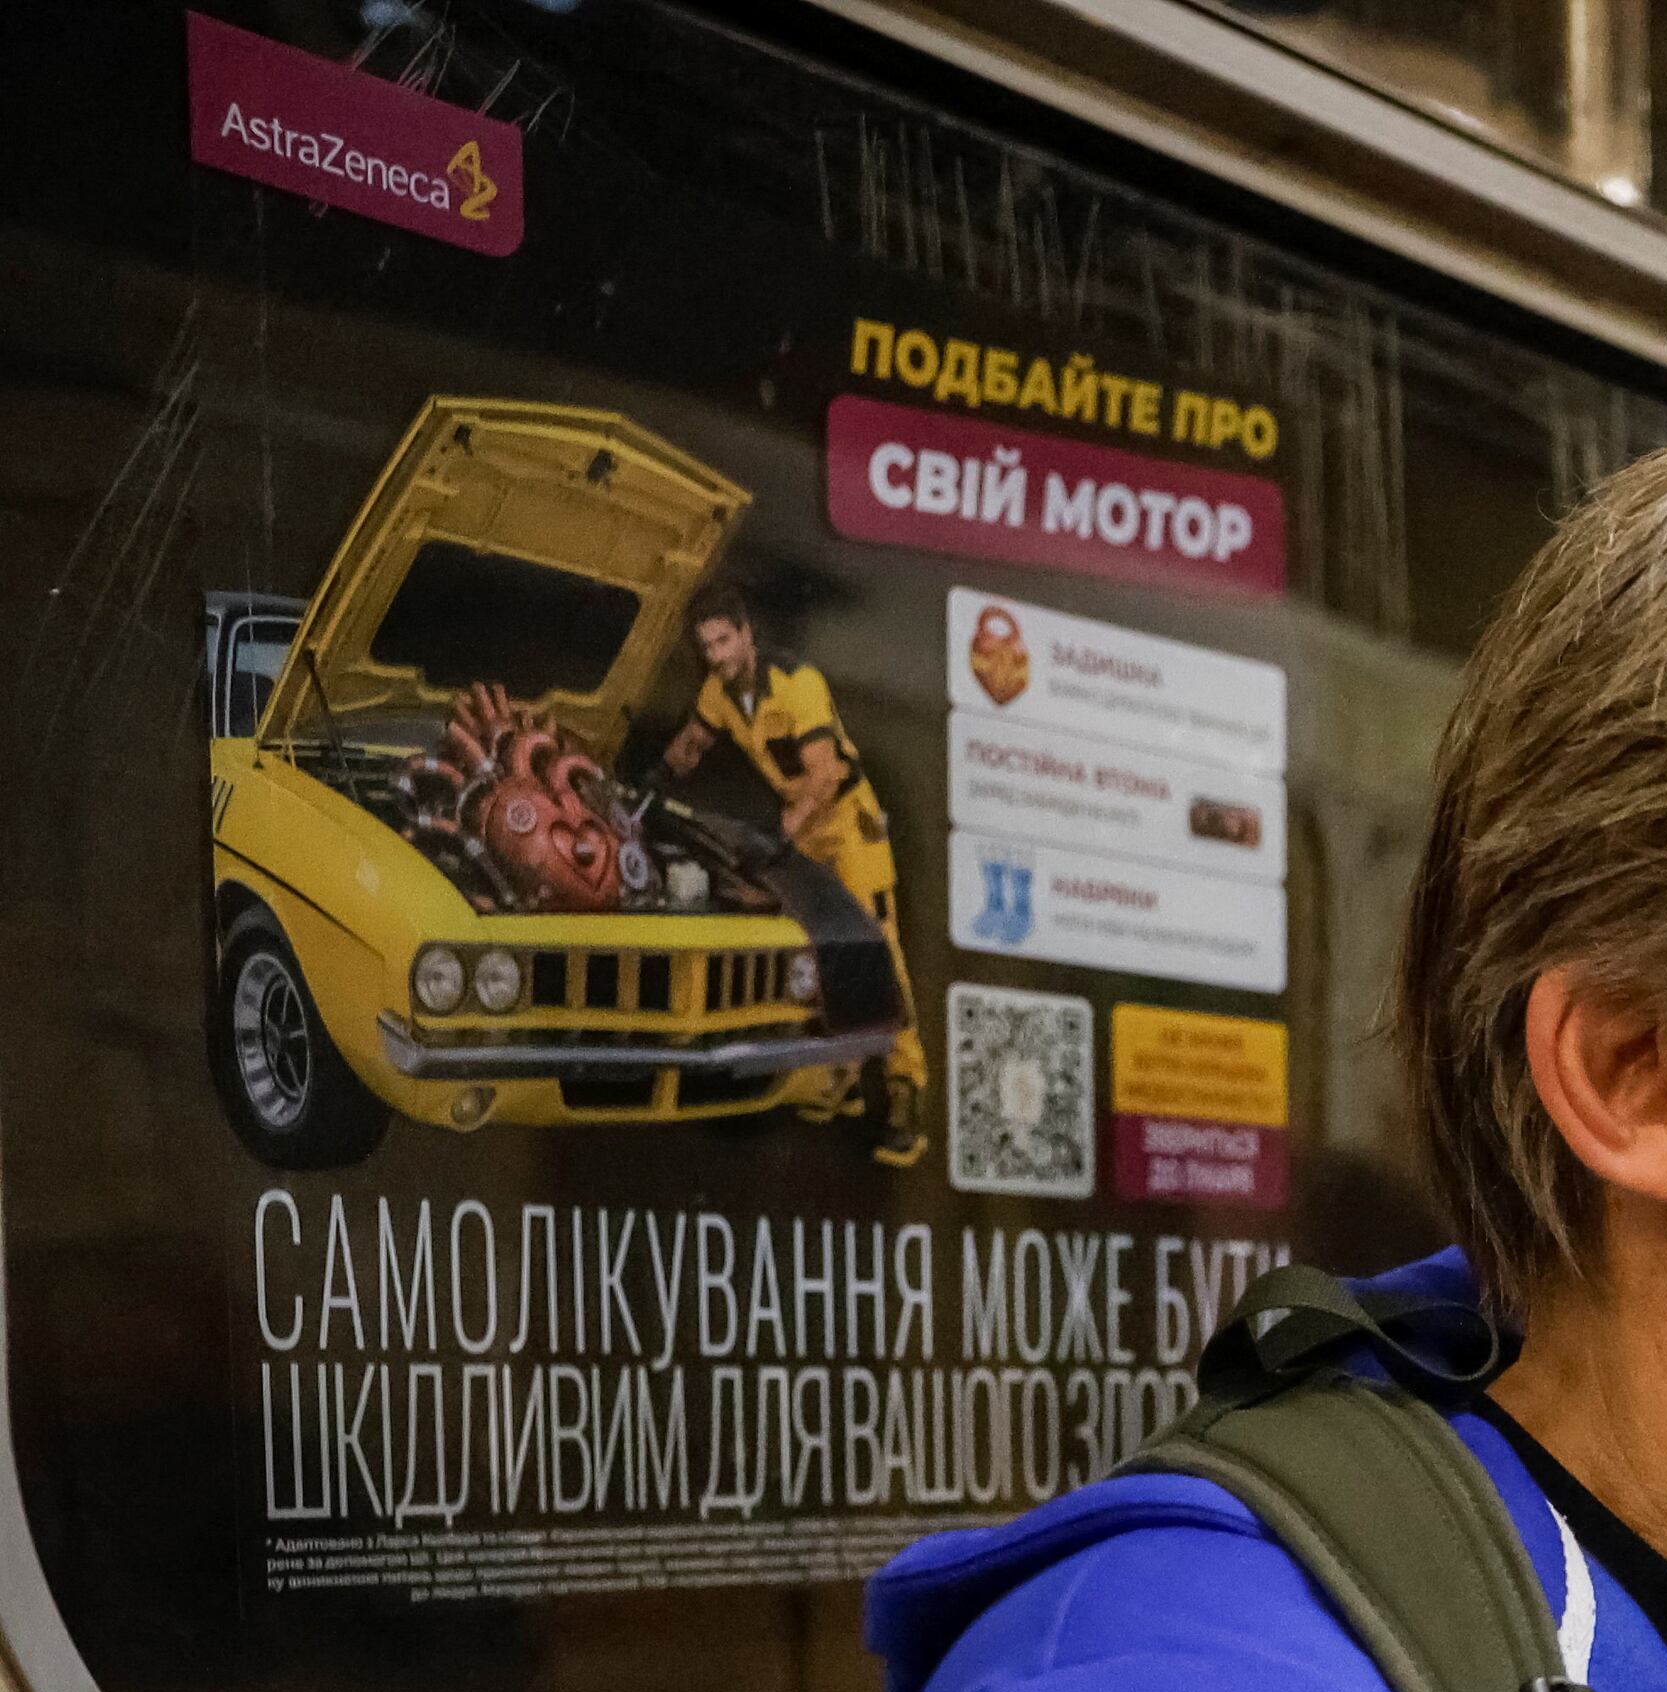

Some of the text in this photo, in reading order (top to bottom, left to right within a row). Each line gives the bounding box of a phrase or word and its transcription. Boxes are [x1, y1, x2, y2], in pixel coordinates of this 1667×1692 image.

[220, 102, 450, 211] AstraZeneca
[851, 319, 1279, 460] ПОДБАЙТЕ ПРО
[869, 443, 1253, 561] СВІЙ МОТОР
[254, 1188, 1292, 1372] САМОЛІКУВАННЯ МОЖЕ БУТ
[261, 1361, 690, 1528] ШКІДЛИВИМ
[699, 1364, 833, 1521] ДЛЯ
[844, 1366, 1061, 1508] ВАШОГО
